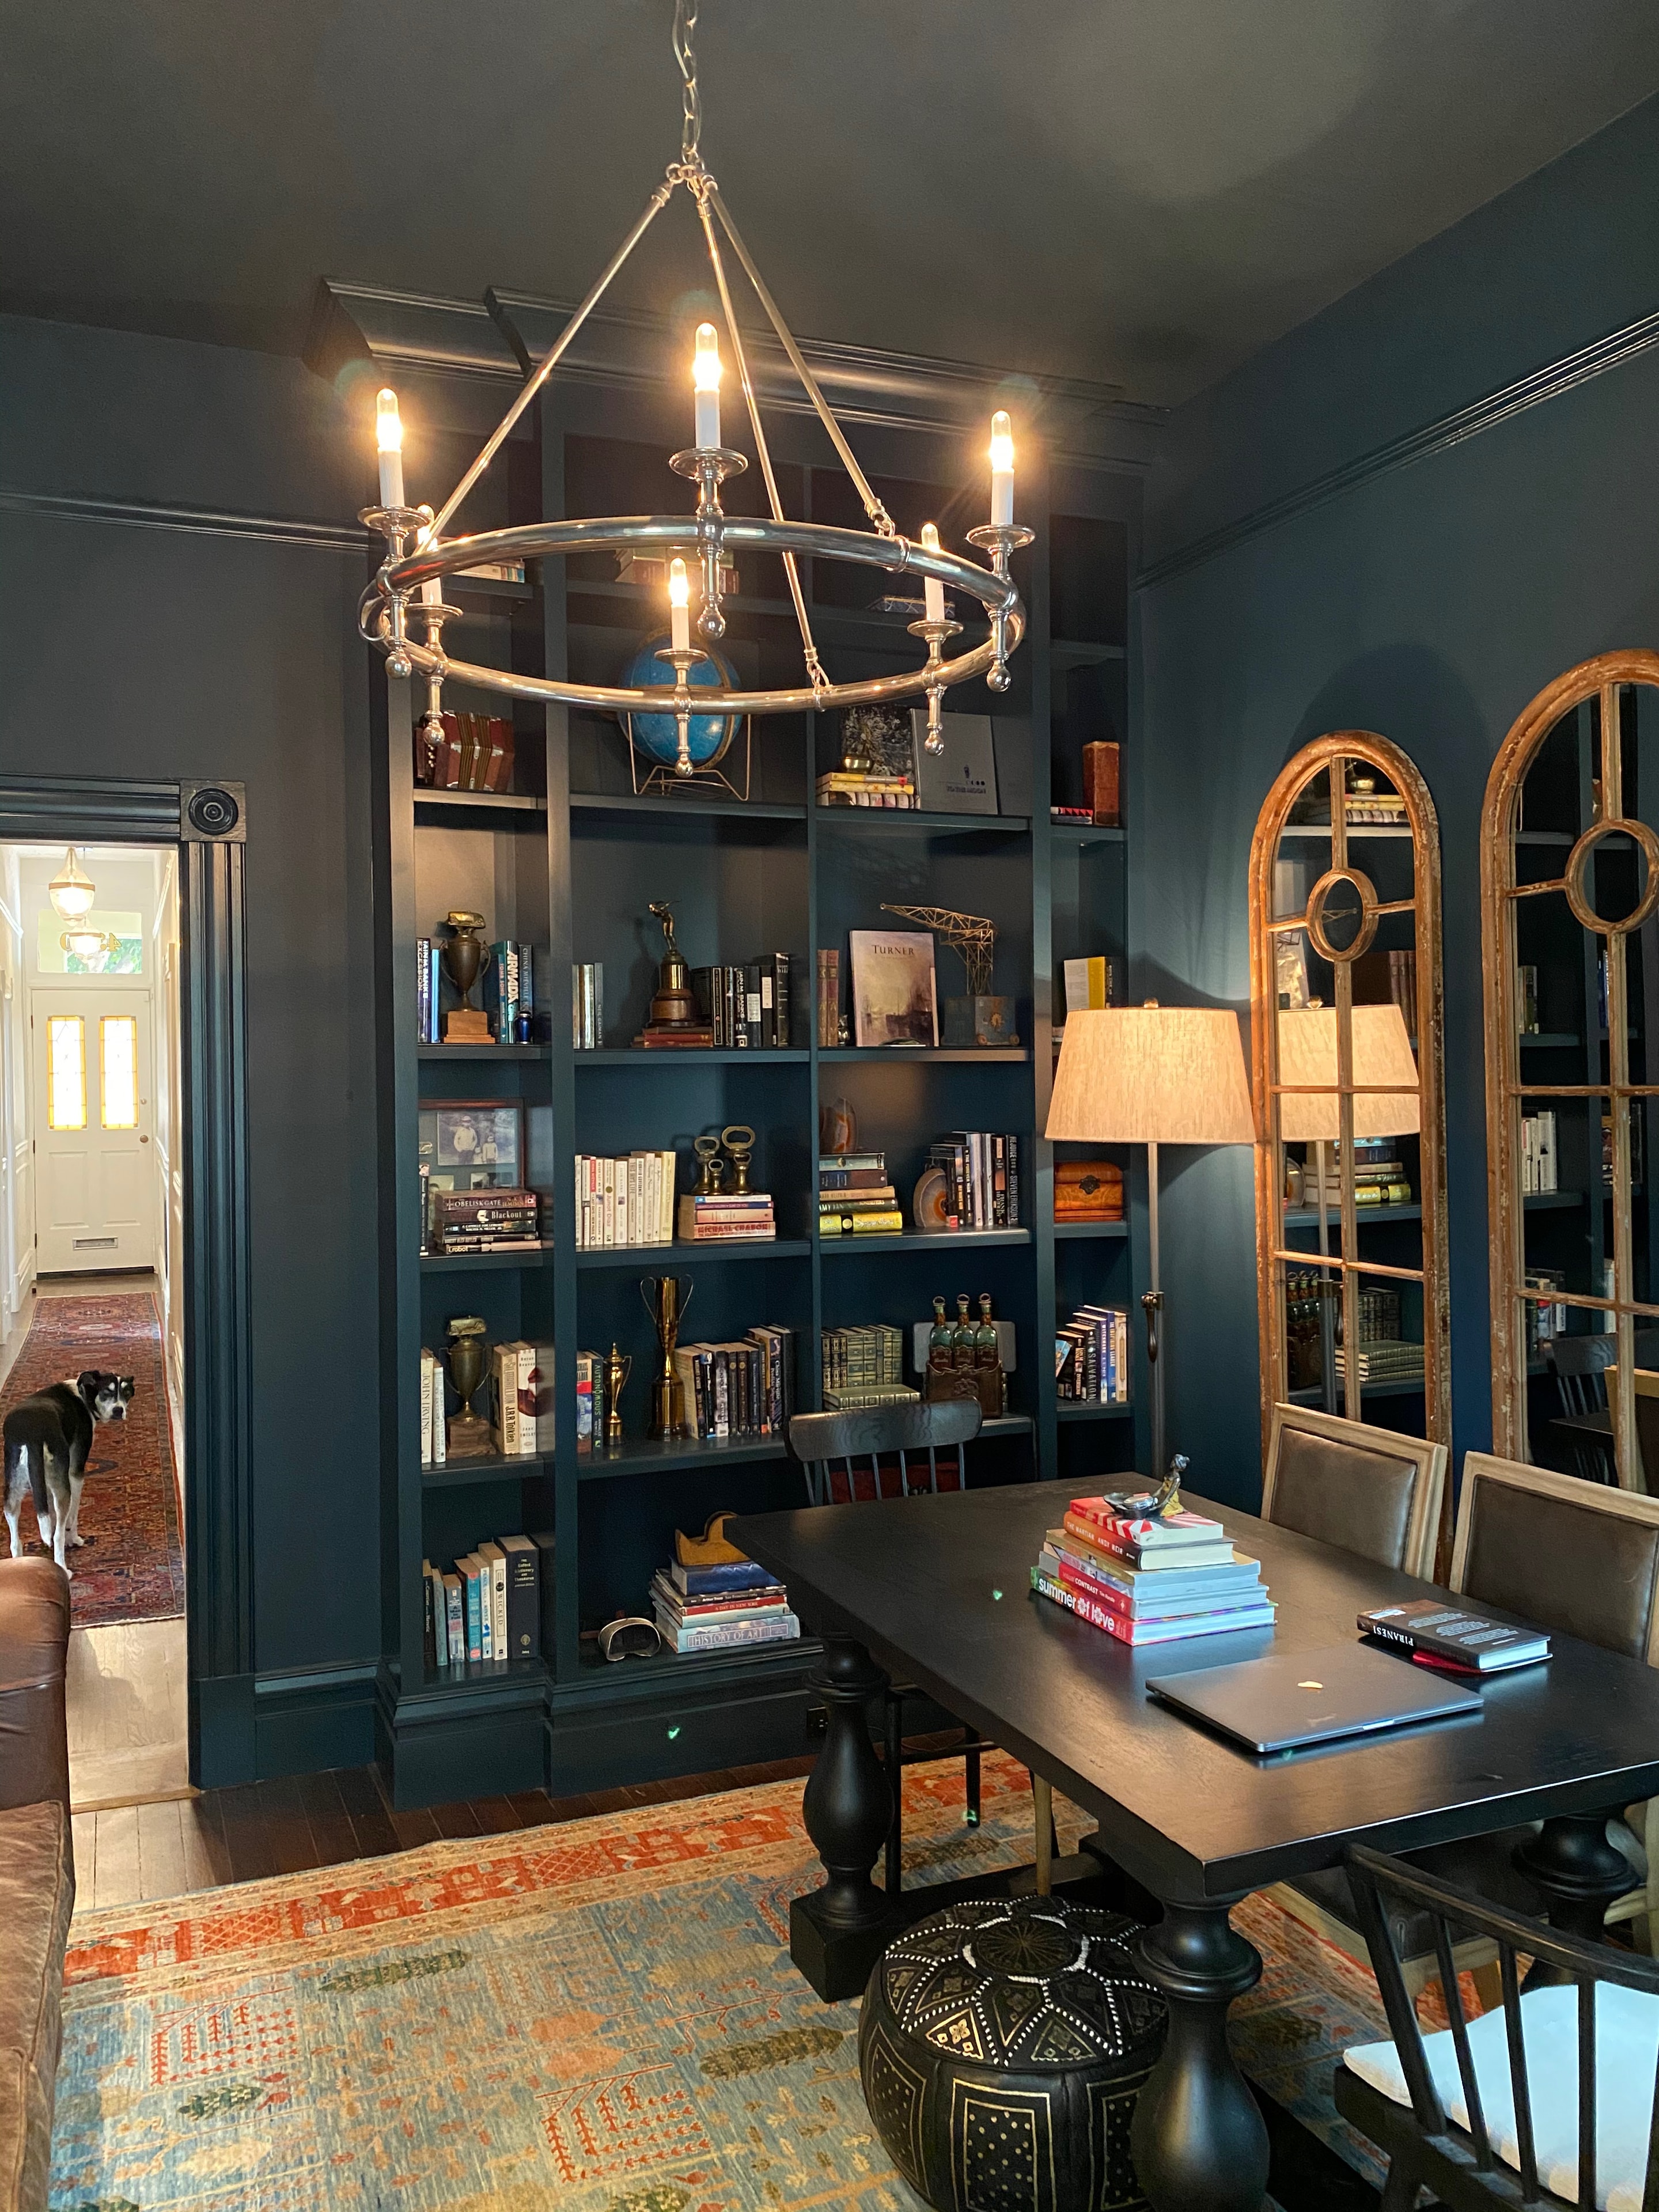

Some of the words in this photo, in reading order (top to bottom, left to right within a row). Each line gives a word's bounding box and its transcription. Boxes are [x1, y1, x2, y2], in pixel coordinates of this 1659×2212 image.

[872, 945, 914, 955] TURNER
[507, 951, 518, 1003] ARMADA
[1010, 1175, 1018, 1194] STEVEN
[491, 1210, 522, 1219] Blackout
[1010, 1195, 1018, 1217] ERIKSON
[422, 1373, 430, 1400] JOHN
[1088, 1353, 1097, 1400] SALVATION
[422, 1402, 430, 1435] IRVING
[506, 1422, 516, 1443] Tolkien
[1066, 1521, 1075, 1531] THE
[1075, 1526, 1094, 1541] MARTIAN
[1097, 1537, 1109, 1549] ANDY
[1111, 1544, 1123, 1555] WEIR
[1074, 1577, 1098, 1595] CONTRAST
[1039, 1578, 1076, 1610] summer
[1077, 1597, 1090, 1619] of
[1091, 1603, 1115, 1632] love
[694, 1634, 731, 1646] HISTORY
[733, 1631, 744, 1641] OF
[747, 1628, 763, 1638] ART
[1373, 1625, 1414, 1646] PIRANESI
